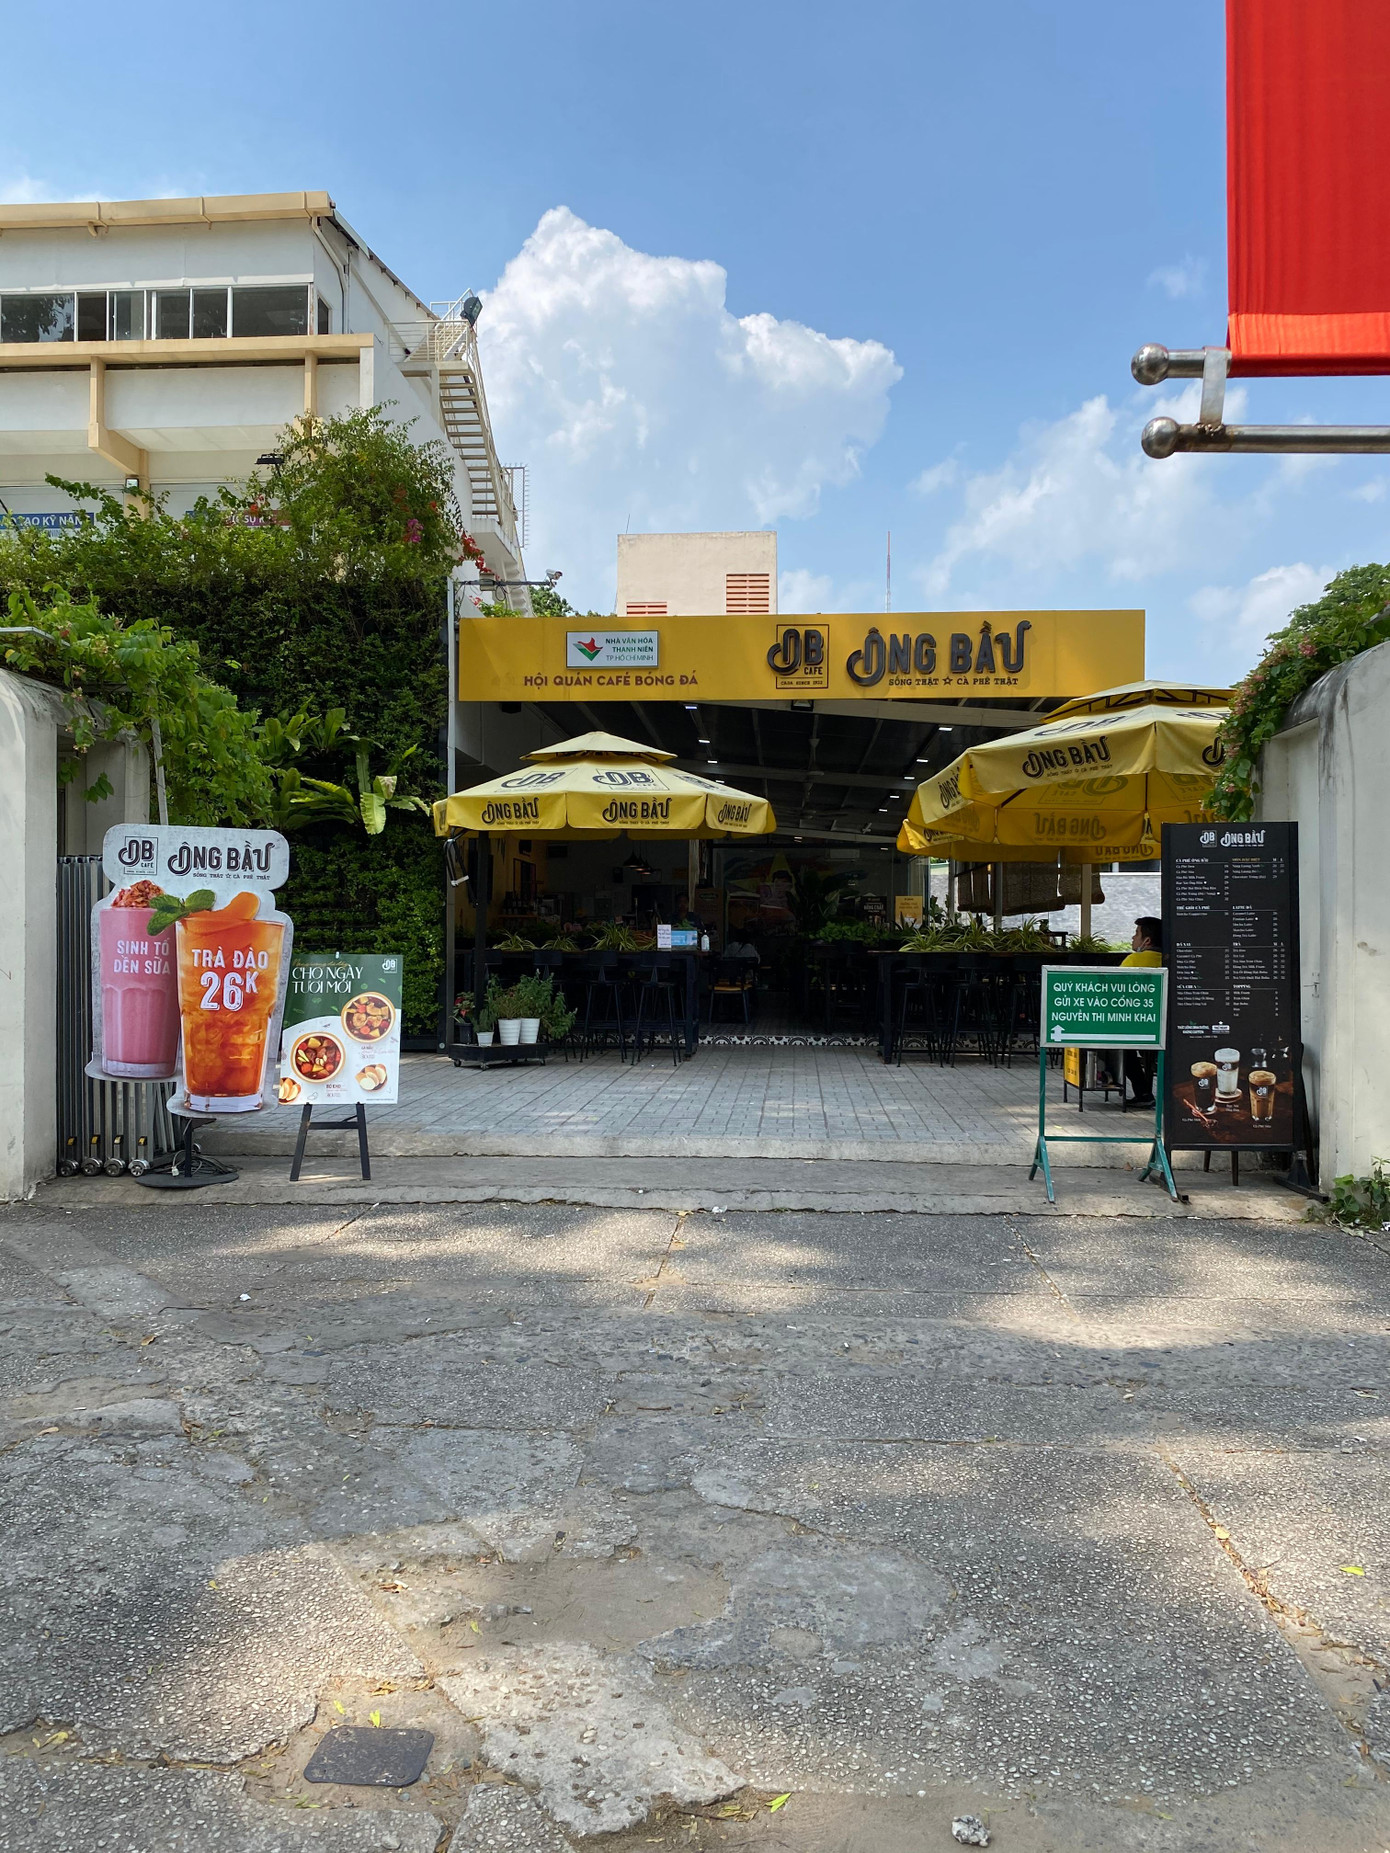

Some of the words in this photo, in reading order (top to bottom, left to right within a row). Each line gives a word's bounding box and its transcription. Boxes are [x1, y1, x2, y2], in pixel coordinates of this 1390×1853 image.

[43, 514, 56, 526] KỸ
[60, 514, 87, 526] NĂN
[767, 628, 824, 676] OB
[846, 626, 936, 687] ÔNG
[952, 620, 1032, 674] BẦU
[524, 672, 548, 690] HỘI
[554, 672, 592, 686] QUÁN
[596, 672, 630, 686] CAFÉ
[635, 672, 674, 686] BÓNG
[680, 670, 698, 685] ĐÁ
[804, 666, 823, 675] CAFE
[889, 676, 912, 686] SỐNG
[915, 678, 939, 686] THẬT
[957, 676, 969, 685] CÀ
[973, 677, 990, 685] PHÊ
[994, 678, 1018, 686] THẬT
[1022, 749, 1068, 779] ÔNG
[1070, 736, 1110, 766] BẦU
[592, 771, 654, 786] OB
[482, 801, 511, 825] ÔNG
[513, 797, 540, 818] BẦU
[602, 798, 638, 824] ÔNG
[641, 796, 673, 818] BẦU
[718, 801, 736, 824] ÔNG
[736, 803, 752, 822] BẦU
[1200, 832, 1215, 844] OB
[1220, 832, 1244, 847] ÔNG
[1245, 830, 1266, 843] BẦU
[118, 839, 155, 868] OB
[167, 842, 222, 877] ÔNG
[227, 840, 276, 872] BẦU
[117, 940, 148, 955] SINH
[154, 938, 170, 956] TỐ
[114, 954, 139, 973] DỀN
[144, 956, 170, 974] SỮA
[191, 946, 225, 968] TRÀ
[232, 947, 269, 969] ĐÀO
[292, 966, 323, 979] CHO
[326, 964, 364, 982] NGÀY
[200, 970, 259, 1011] 26K
[292, 981, 323, 993] TƯƠI
[326, 978, 351, 993] MỚI
[1053, 981, 1073, 992] QUÝ
[1076, 981, 1108, 992] KHÁCH
[1111, 984, 1126, 992] VUI
[1128, 982, 1156, 993] LÒNG
[1054, 995, 1070, 1006] GỬI
[1073, 998, 1084, 1006] XE
[1087, 996, 1108, 1007] VÀO
[1111, 995, 1140, 1007] CỔNG
[1143, 999, 1154, 1007] 35
[1092, 1013, 1105, 1023] THỊ
[1108, 1013, 1131, 1021] MINH
[1134, 1013, 1156, 1022] KHAI
